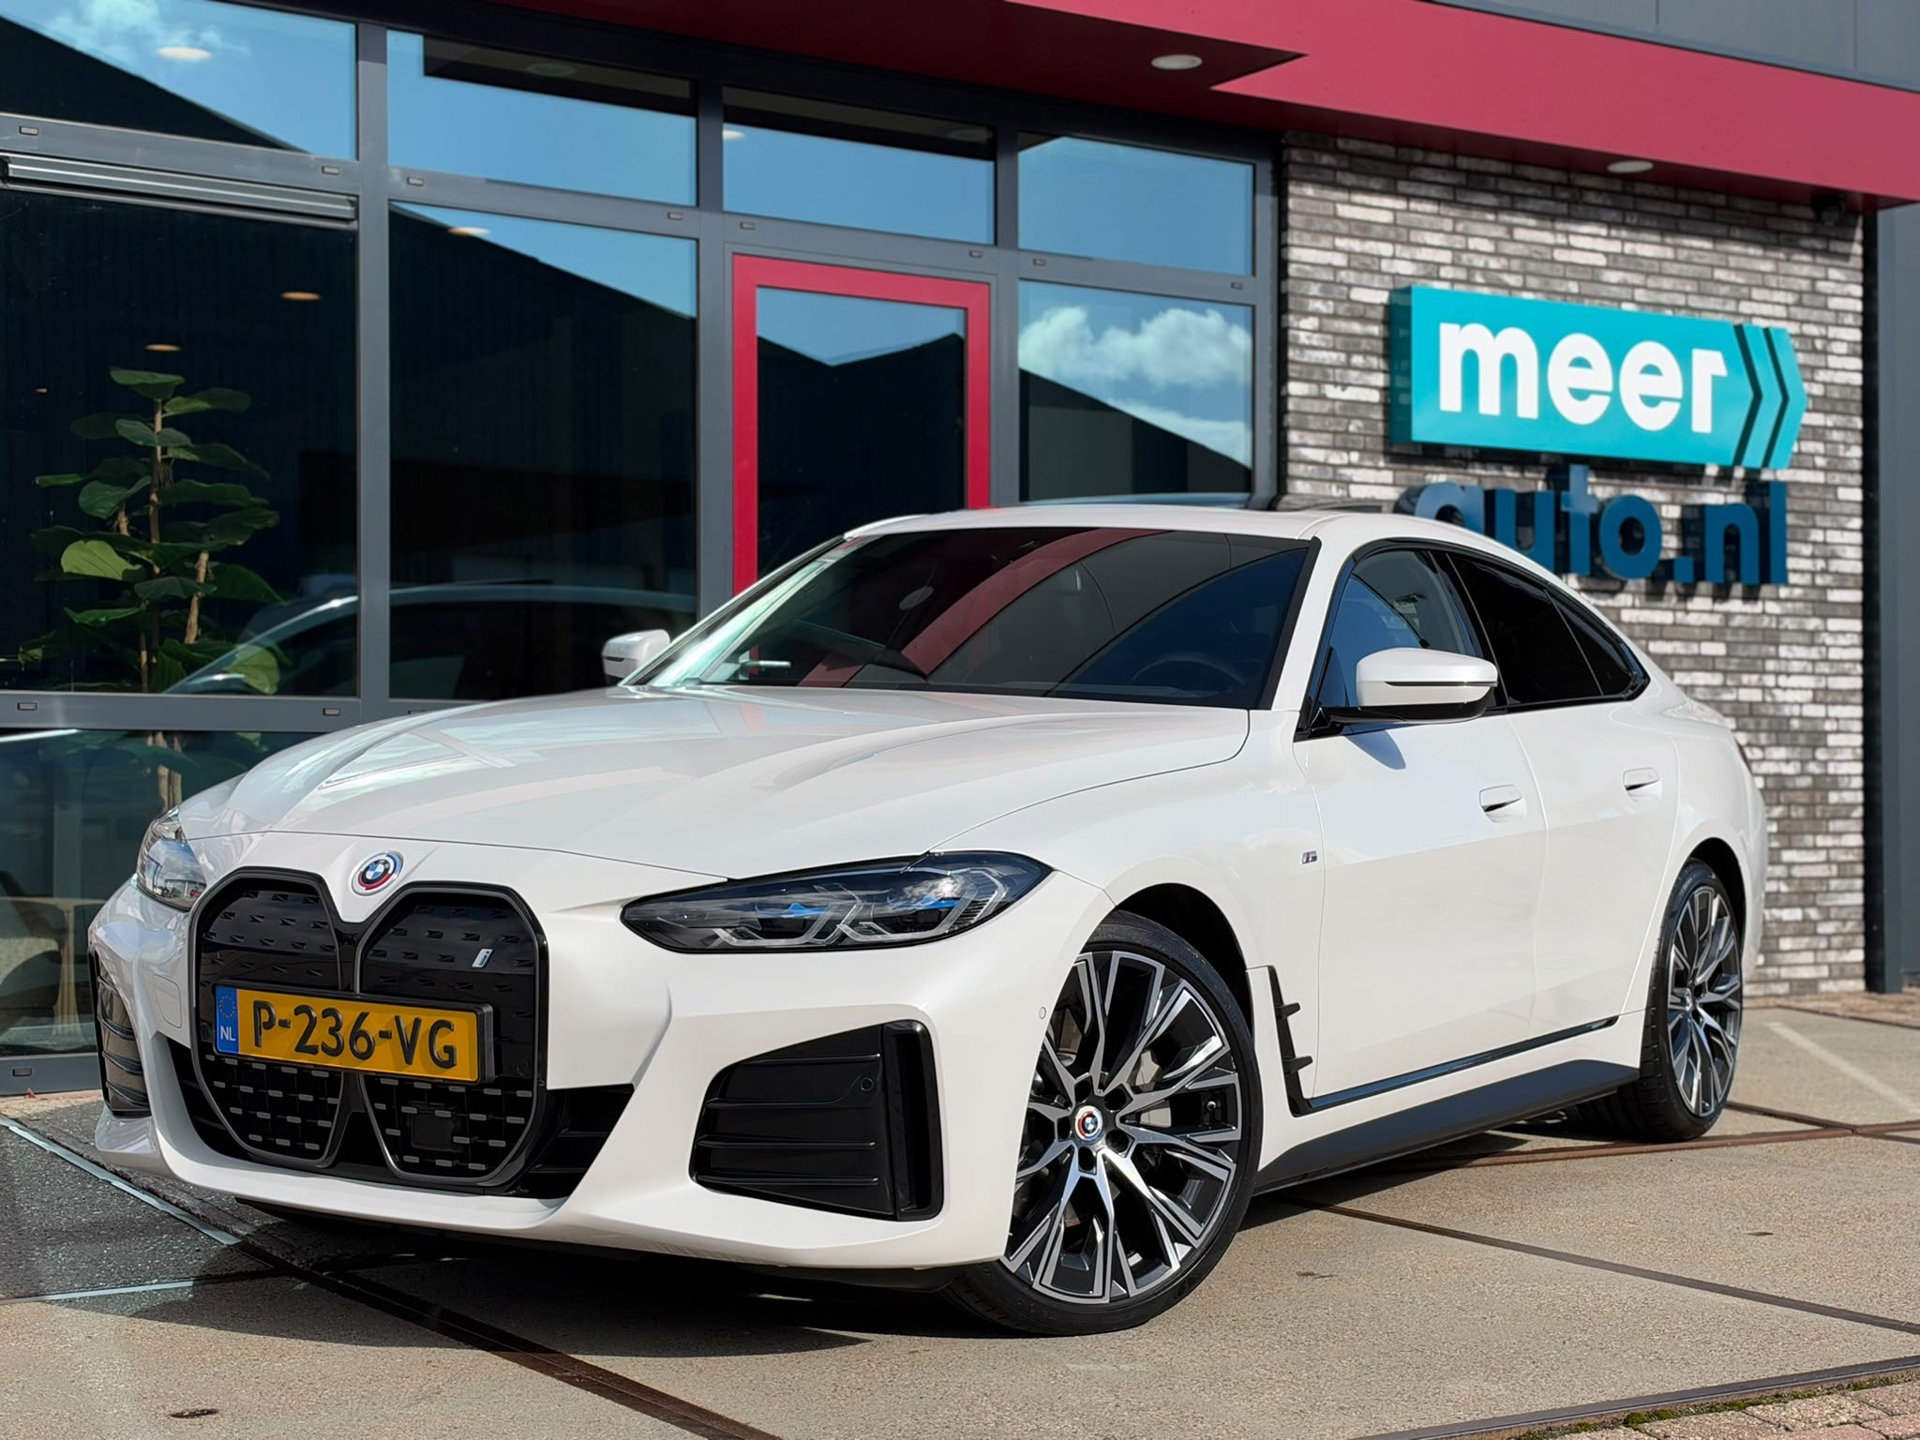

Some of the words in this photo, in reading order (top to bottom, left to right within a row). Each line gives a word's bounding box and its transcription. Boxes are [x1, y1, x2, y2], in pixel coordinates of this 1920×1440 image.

[1439, 322, 1729, 434] meer
[219, 1024, 237, 1042] NL
[252, 1000, 457, 1069] P-236-VG
